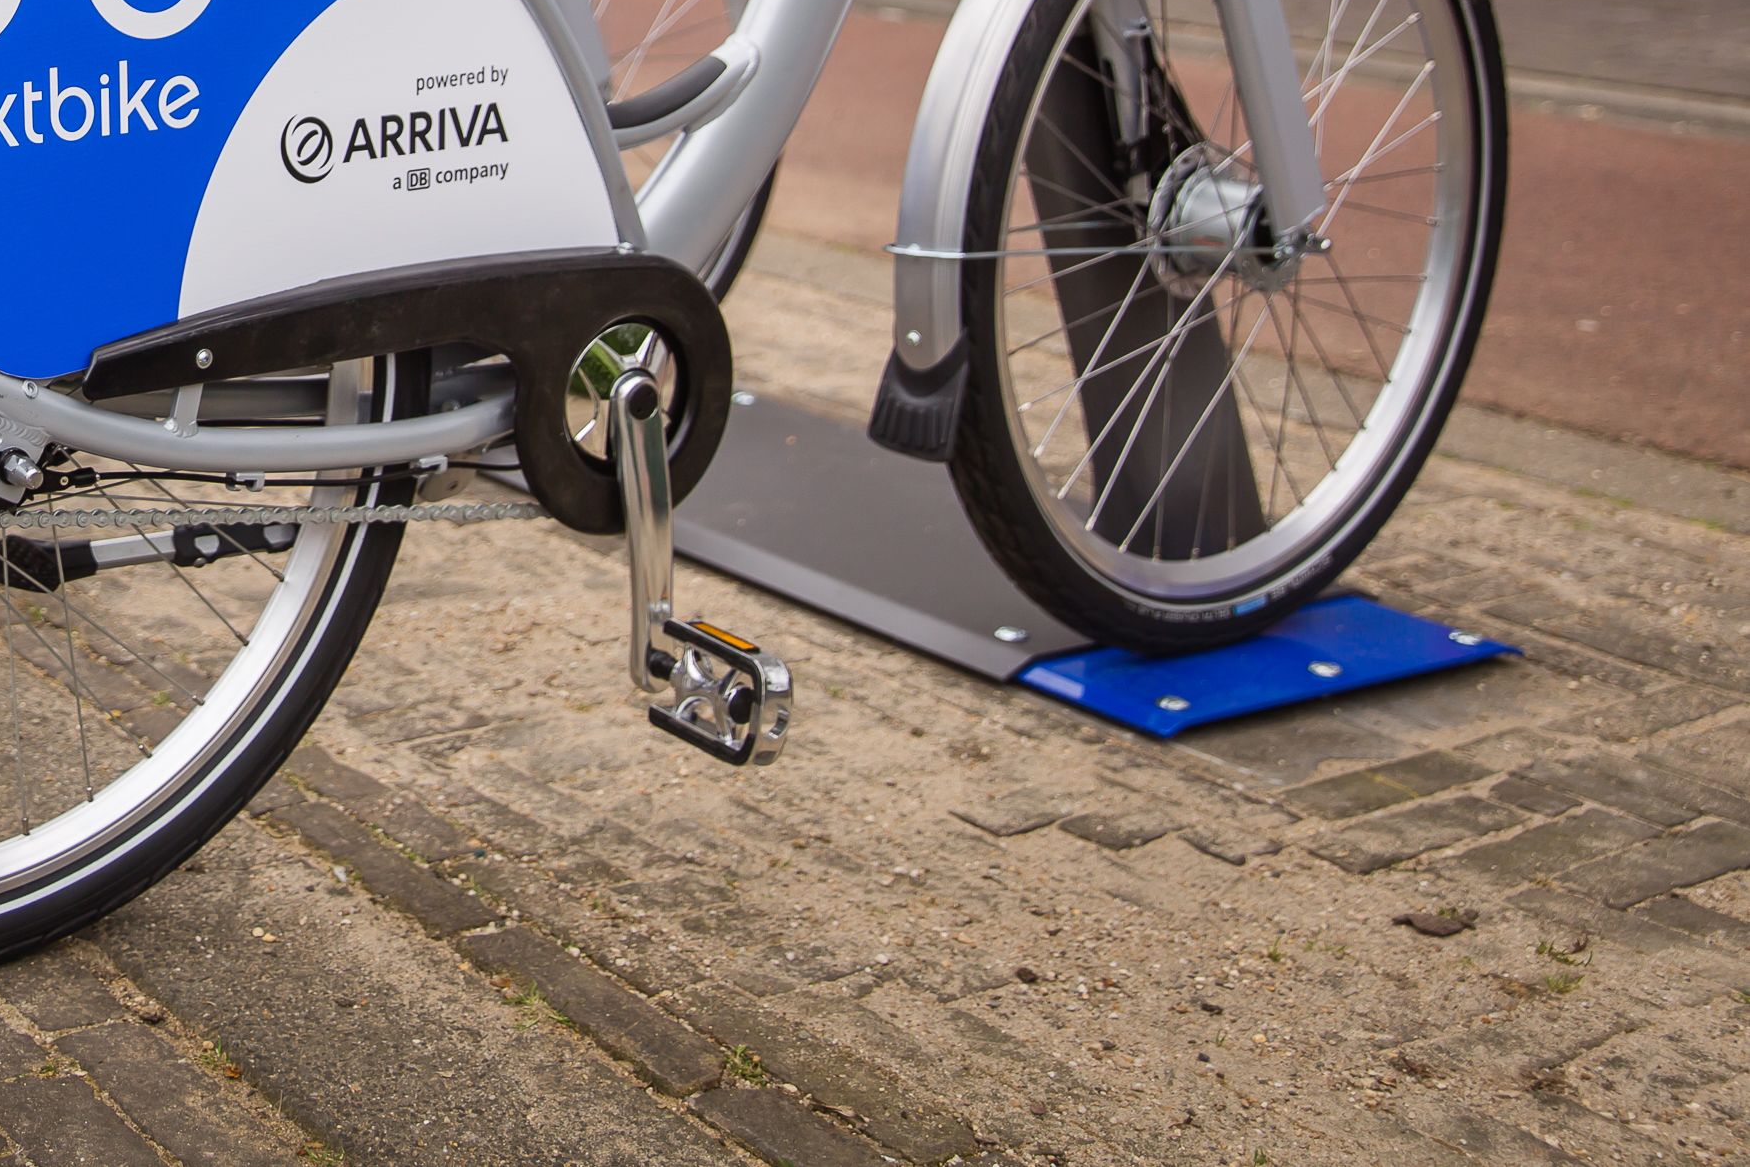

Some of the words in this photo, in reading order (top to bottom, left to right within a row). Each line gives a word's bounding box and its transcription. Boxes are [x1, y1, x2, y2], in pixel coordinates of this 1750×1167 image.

[415, 66, 486, 95] powered
[490, 65, 509, 86] by
[342, 102, 509, 164] ARRIVA
[392, 176, 402, 190] a
[408, 170, 429, 189] DB
[435, 161, 509, 184] company
